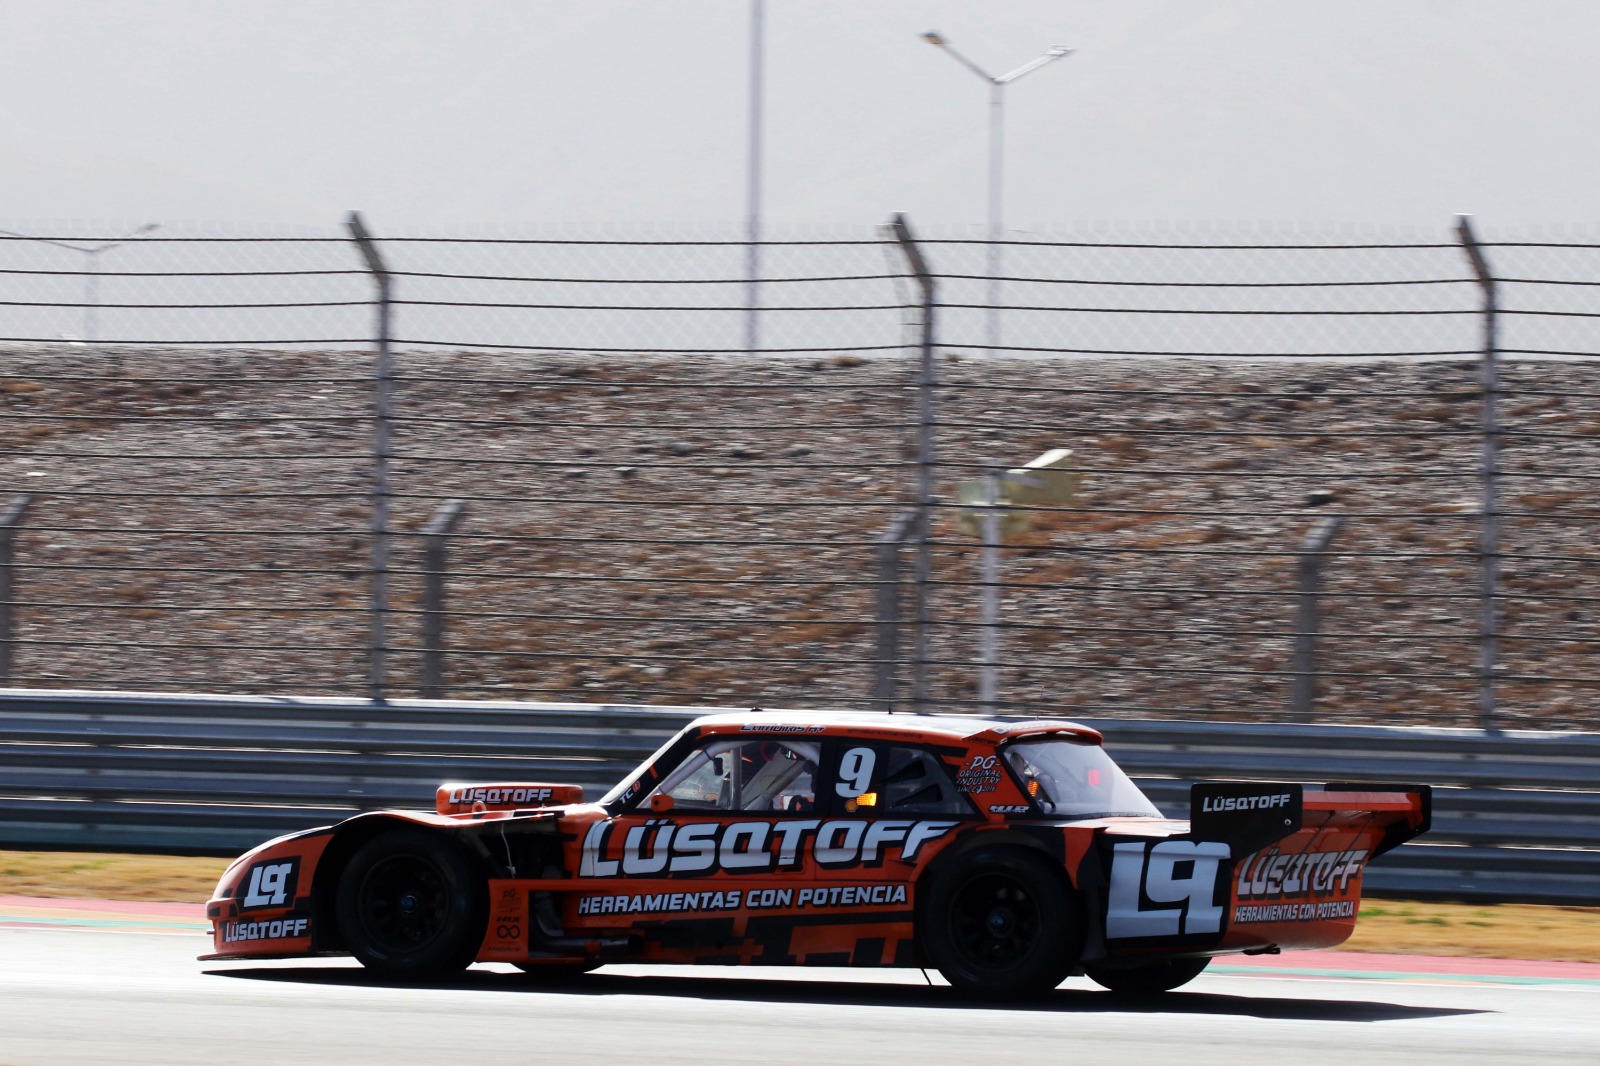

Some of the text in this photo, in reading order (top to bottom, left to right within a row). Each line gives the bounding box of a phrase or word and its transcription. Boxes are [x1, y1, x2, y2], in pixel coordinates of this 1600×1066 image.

[835, 747, 876, 798] 9
[956, 776, 1001, 786] INDUSTRY
[959, 769, 1001, 777] ORIGINAL
[1203, 794, 1290, 812] LÜSQTOFF
[579, 818, 959, 877] LÜSQTOFF
[1236, 848, 1369, 896] LÜSQTOFF
[578, 885, 906, 914] HERRAMIENTAS CON POTENCIA
[1234, 901, 1354, 923] HERRAMIENTAS CON POTENCIA
[225, 919, 308, 942] LÜSQTOFF
